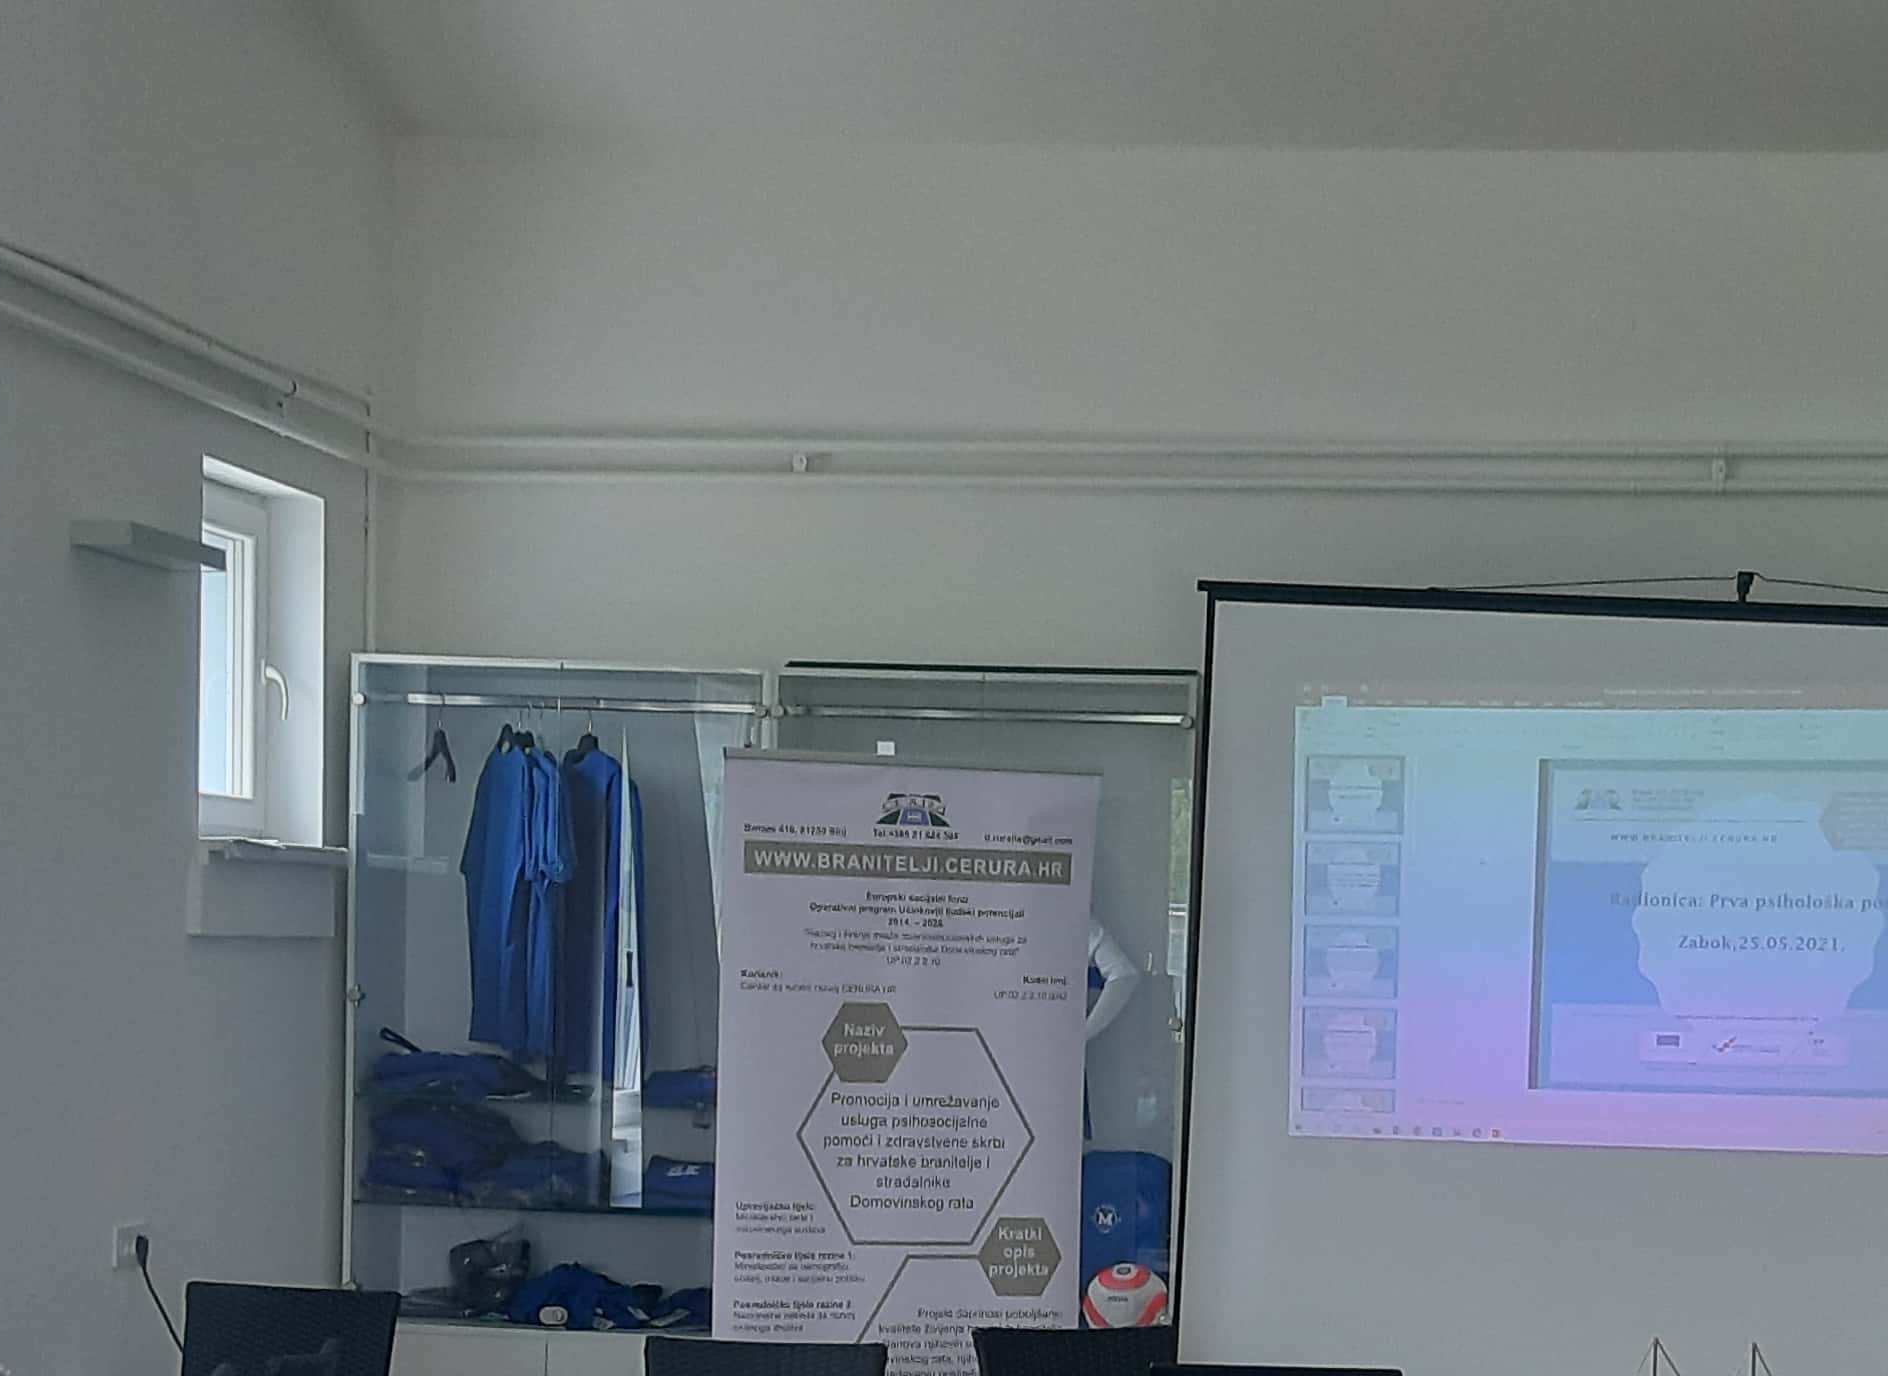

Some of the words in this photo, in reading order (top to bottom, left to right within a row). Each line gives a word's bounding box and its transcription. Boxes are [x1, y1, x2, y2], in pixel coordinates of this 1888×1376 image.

[754, 849, 1063, 878] WWW.BRANITELJI.CERURA.HR
[1709, 893, 1749, 909] Prva
[844, 1023, 886, 1037] Naziv
[833, 1041, 894, 1058] projekta
[831, 1092, 900, 1109] Promocija
[912, 1094, 1000, 1112] umrežavanje
[841, 1114, 887, 1130] usluga
[891, 1114, 988, 1131] psihosocijalne
[823, 1133, 873, 1149] pomoći
[886, 1135, 968, 1148] zdravstvene
[972, 1136, 1005, 1149] skrbi
[837, 1156, 853, 1167] za
[857, 1154, 917, 1168] hrvatske
[920, 1155, 982, 1172] branitelje
[876, 1175, 951, 1189] stradalnike
[850, 1195, 944, 1211] Domovinskog
[948, 1197, 974, 1210] rata
[998, 1226, 1042, 1241] Kratki
[1003, 1244, 1035, 1262] opis
[988, 1263, 1049, 1278] projekta
